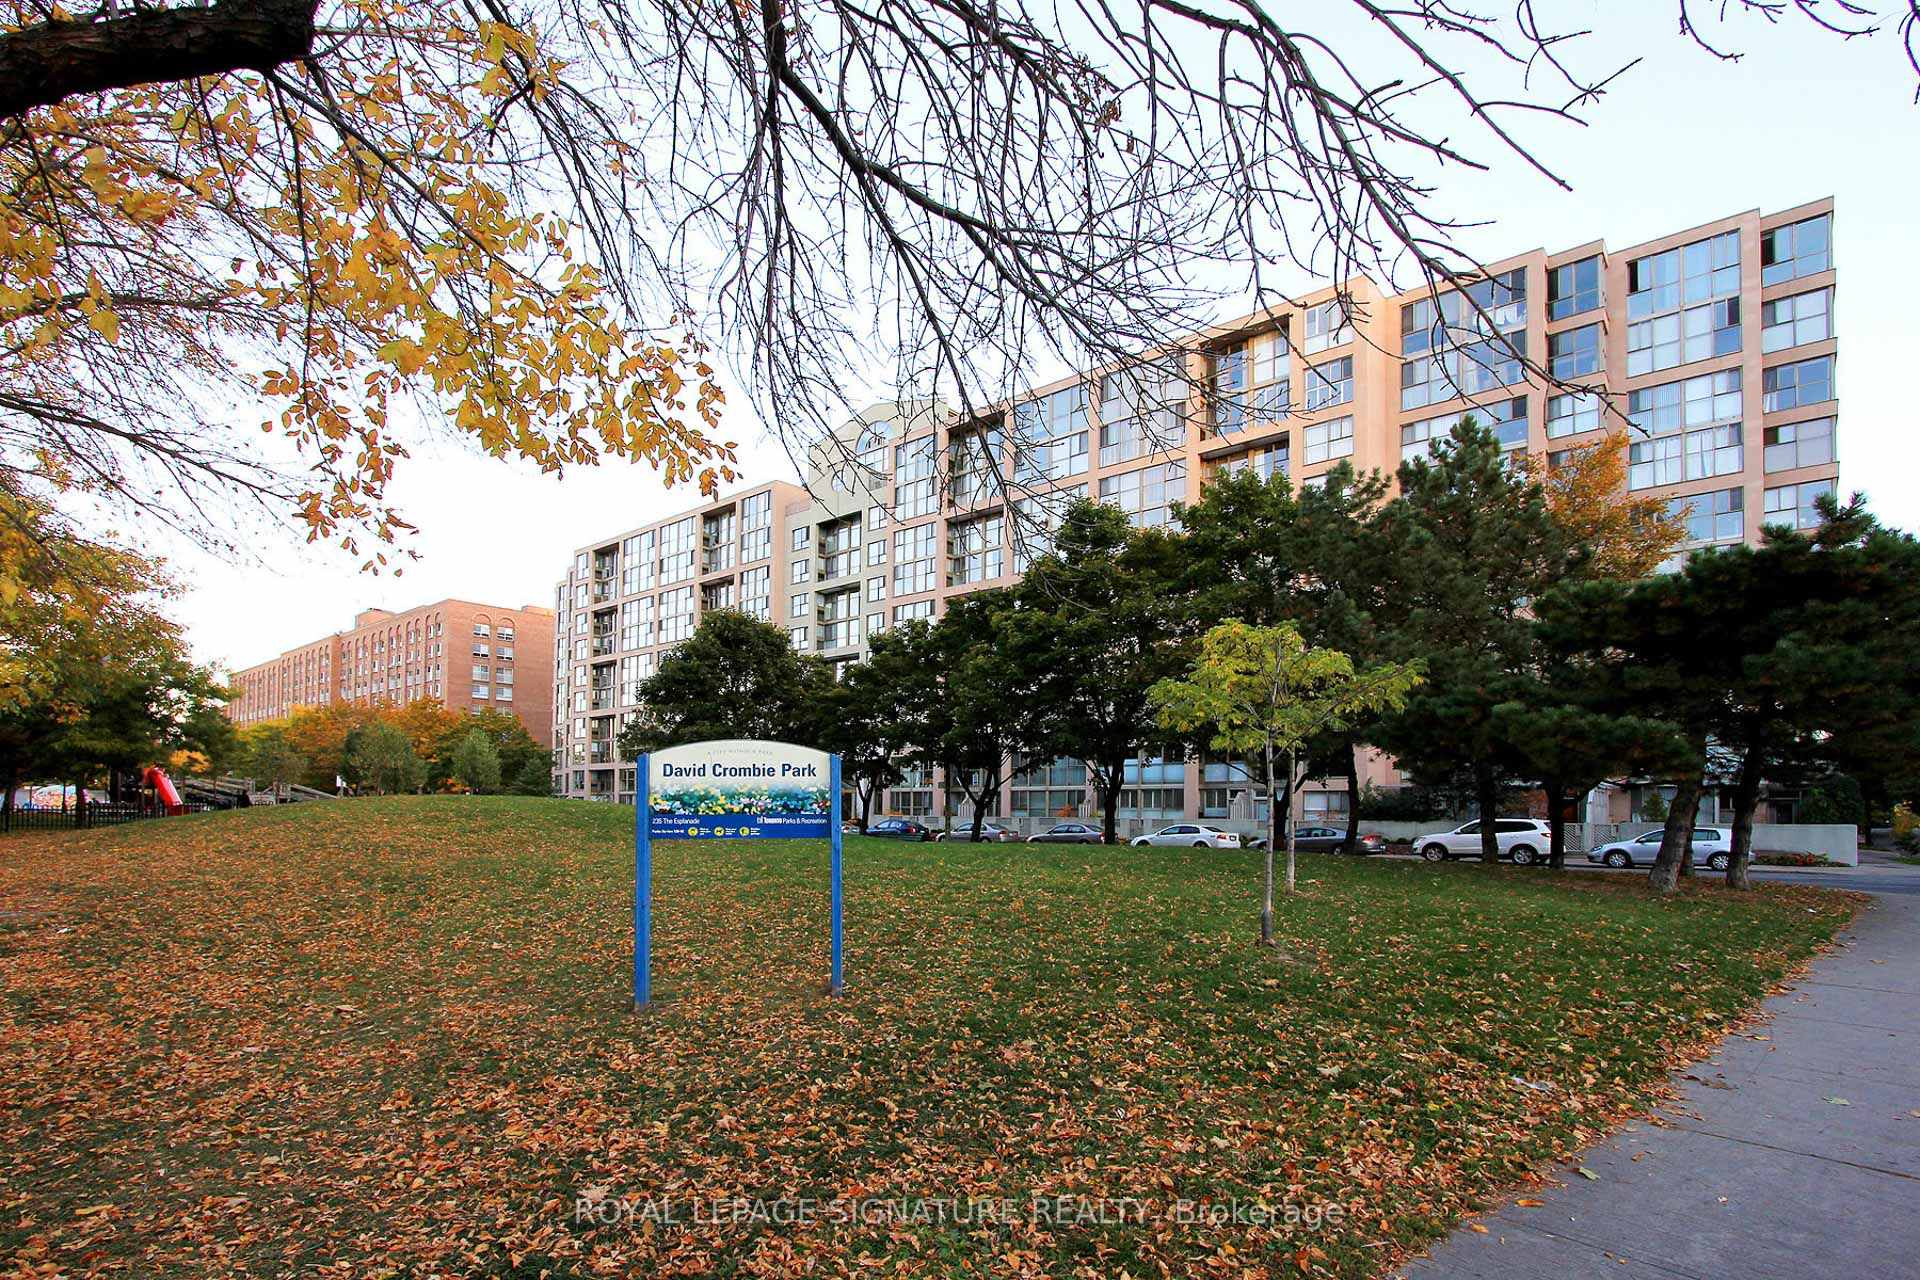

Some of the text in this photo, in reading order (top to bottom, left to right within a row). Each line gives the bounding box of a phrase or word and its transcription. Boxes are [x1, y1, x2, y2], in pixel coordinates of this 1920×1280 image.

[662, 763, 817, 777] David Crombie Park
[663, 817, 673, 825] The
[673, 817, 700, 826] Esplanade
